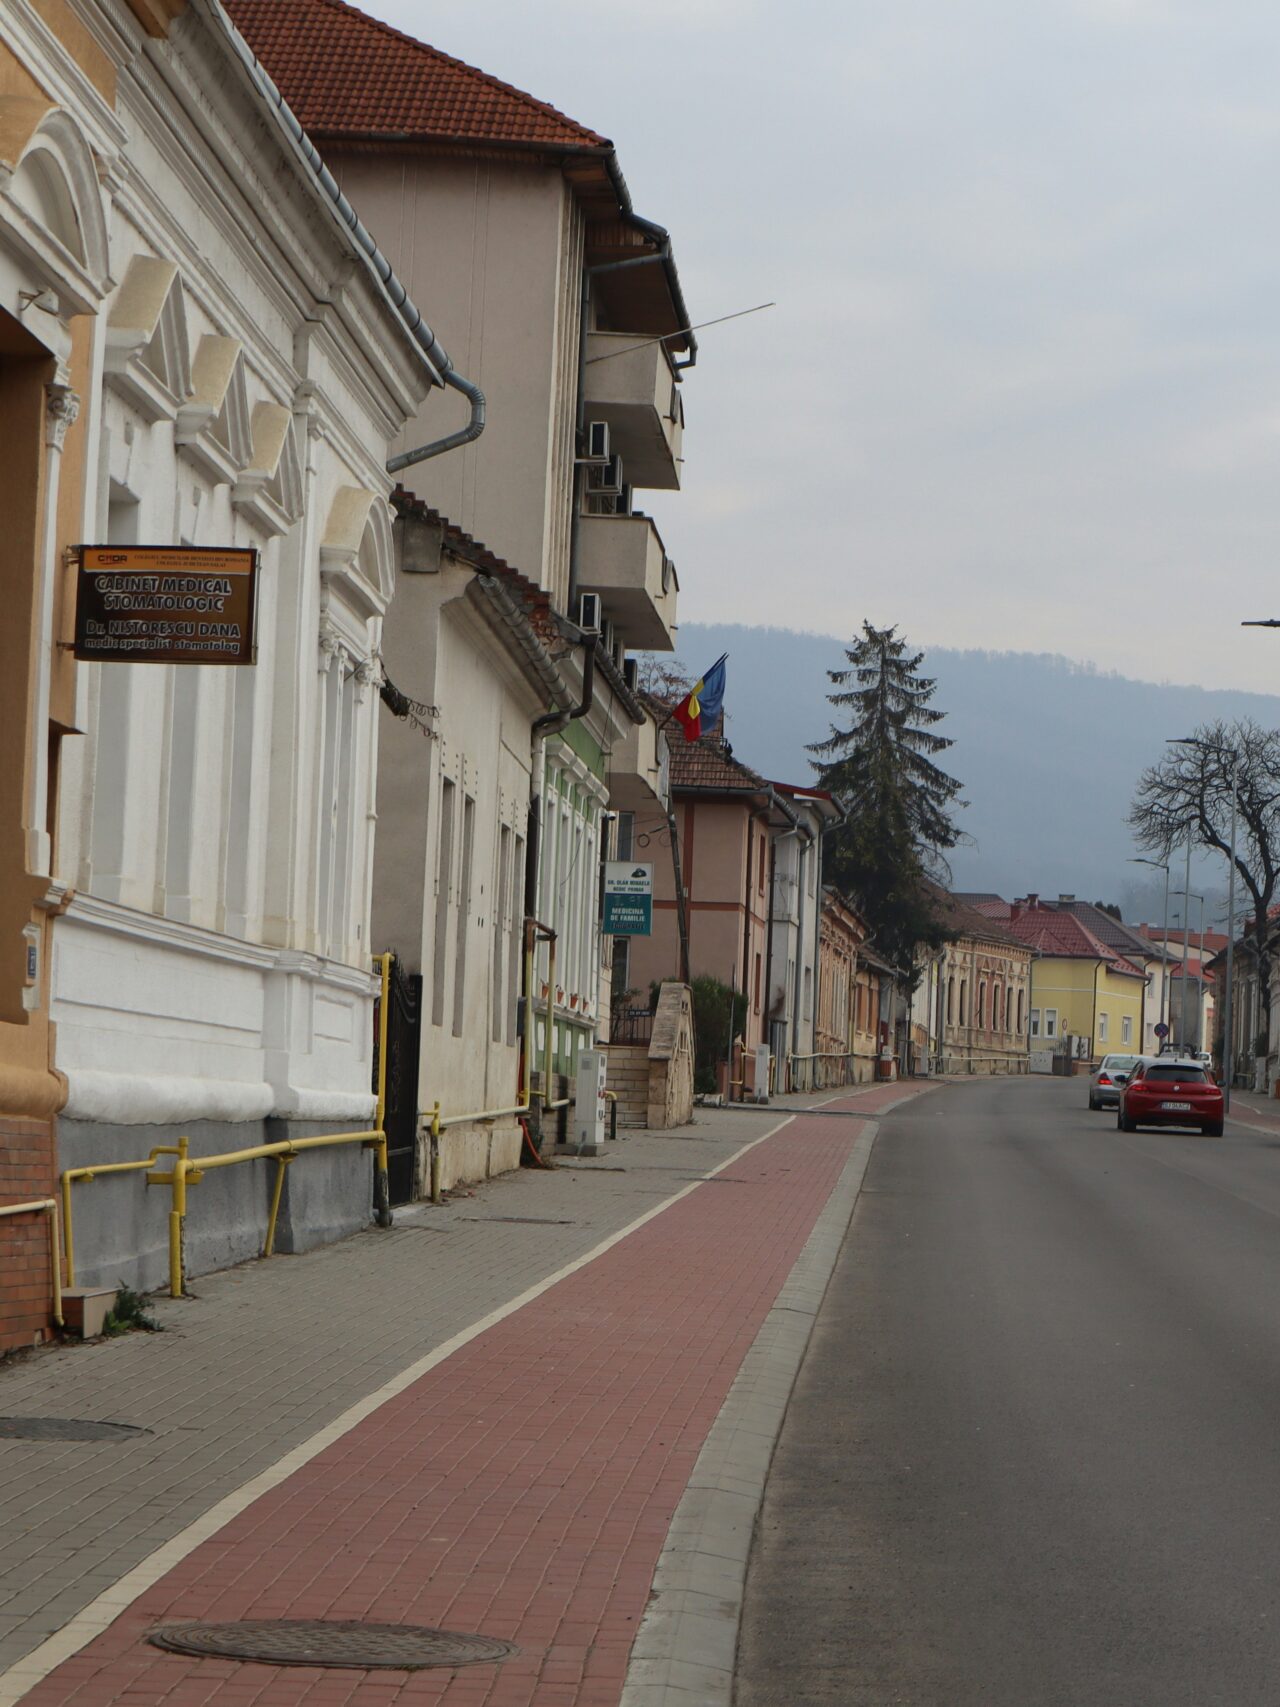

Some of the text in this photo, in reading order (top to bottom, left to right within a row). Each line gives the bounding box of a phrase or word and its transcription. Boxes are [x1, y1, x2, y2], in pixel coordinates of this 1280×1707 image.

[95, 575, 232, 596] CABINET MEDICAL
[104, 594, 224, 613] STOMATOLOGIC
[86, 619, 241, 638] Dr. NISTORESCU DANA
[85, 635, 240, 655] medic specialist stomatolog
[611, 907, 644, 915] MEDICINA
